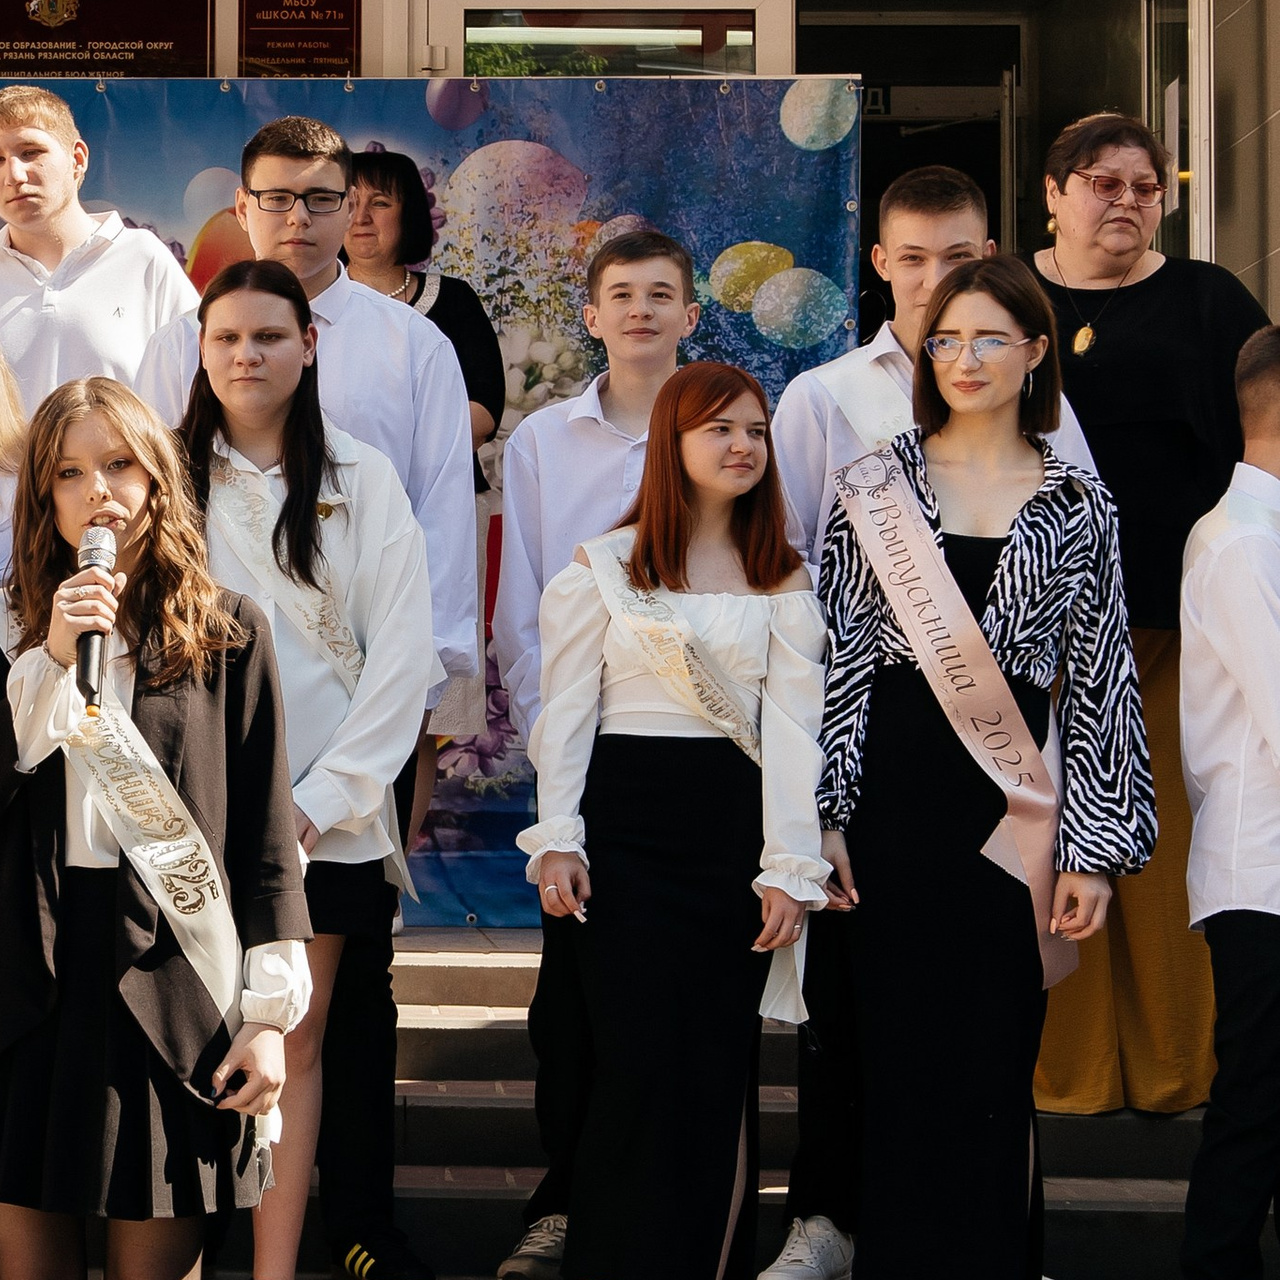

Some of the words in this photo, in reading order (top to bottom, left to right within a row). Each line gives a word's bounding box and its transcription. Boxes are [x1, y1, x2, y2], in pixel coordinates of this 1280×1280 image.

[256, 10, 306, 20] «ШКОЛА
[12, 41, 76, 50] ОБРАЗОВАНИЕ
[87, 40, 143, 50] ГОРОДСКОЙ
[146, 41, 174, 50] ОКРУГ
[3, 52, 35, 60] РЯЗАНЬ
[38, 50, 90, 60] РЯЗАНСКОЙ
[93, 52, 134, 60] ОБЛАСТИ
[249, 57, 306, 65] ПОНЕДЕЛЬНИК
[313, 57, 349, 65] ПЯТНИЦА
[869, 496, 976, 696] Выпускница
[970, 711, 1034, 787] 2025
[142, 817, 220, 915] 2025
